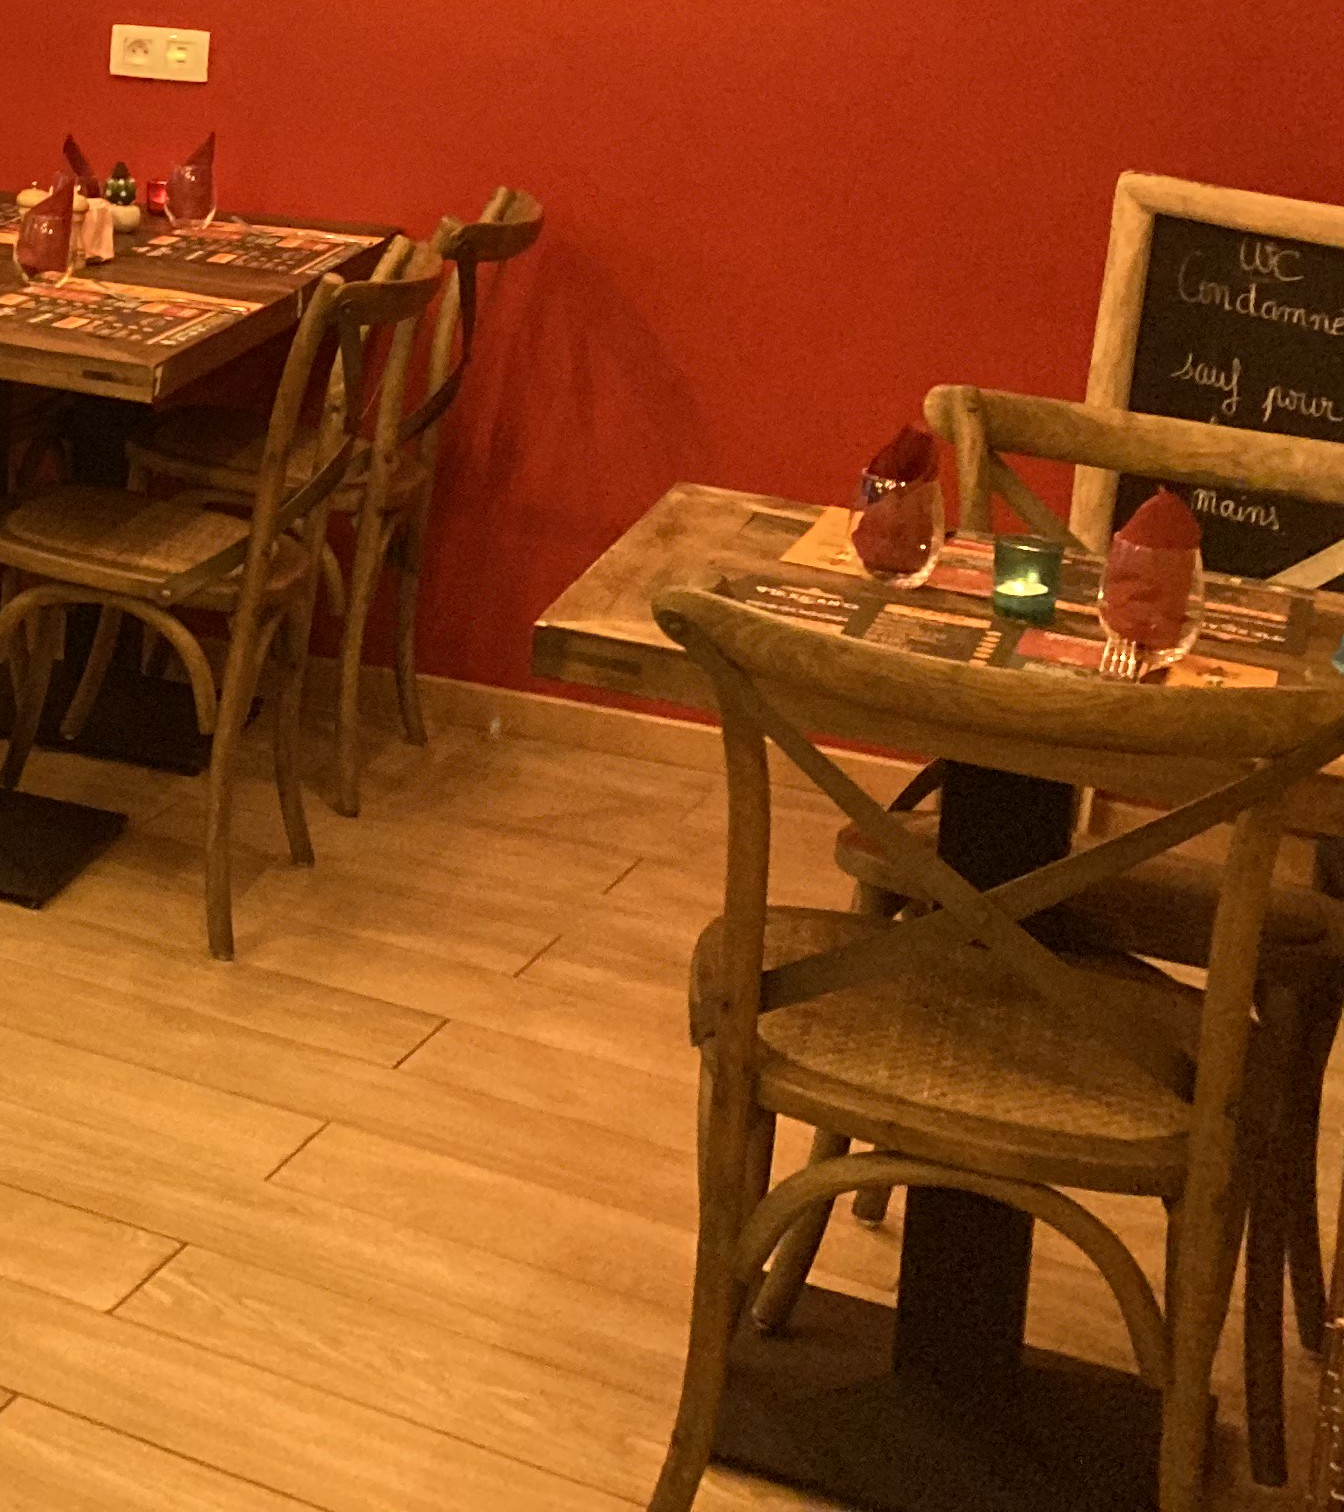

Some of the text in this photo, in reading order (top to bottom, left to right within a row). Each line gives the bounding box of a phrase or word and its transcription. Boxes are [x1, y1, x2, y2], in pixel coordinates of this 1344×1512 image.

[1240, 238, 1305, 281] WC
[1171, 352, 1344, 423] sauf pour
